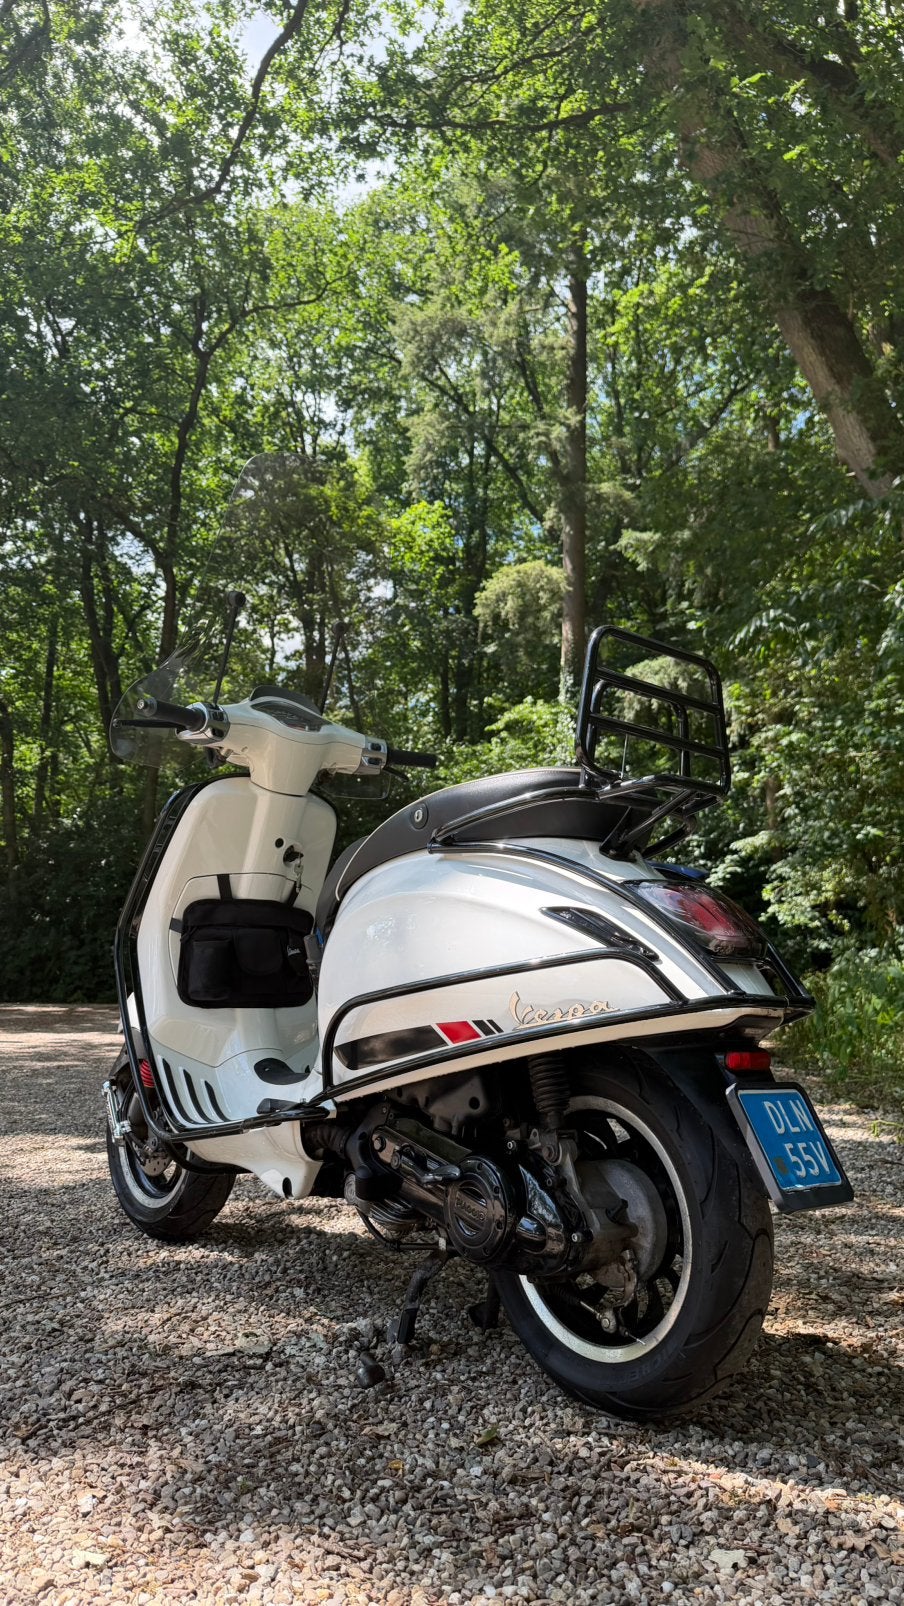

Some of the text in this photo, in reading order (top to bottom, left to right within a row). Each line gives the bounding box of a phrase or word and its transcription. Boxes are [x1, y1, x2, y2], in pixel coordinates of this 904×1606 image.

[509, 991, 619, 1031] Vespa
[763, 1099, 814, 1135] DLN
[784, 1141, 831, 1178] 55V
